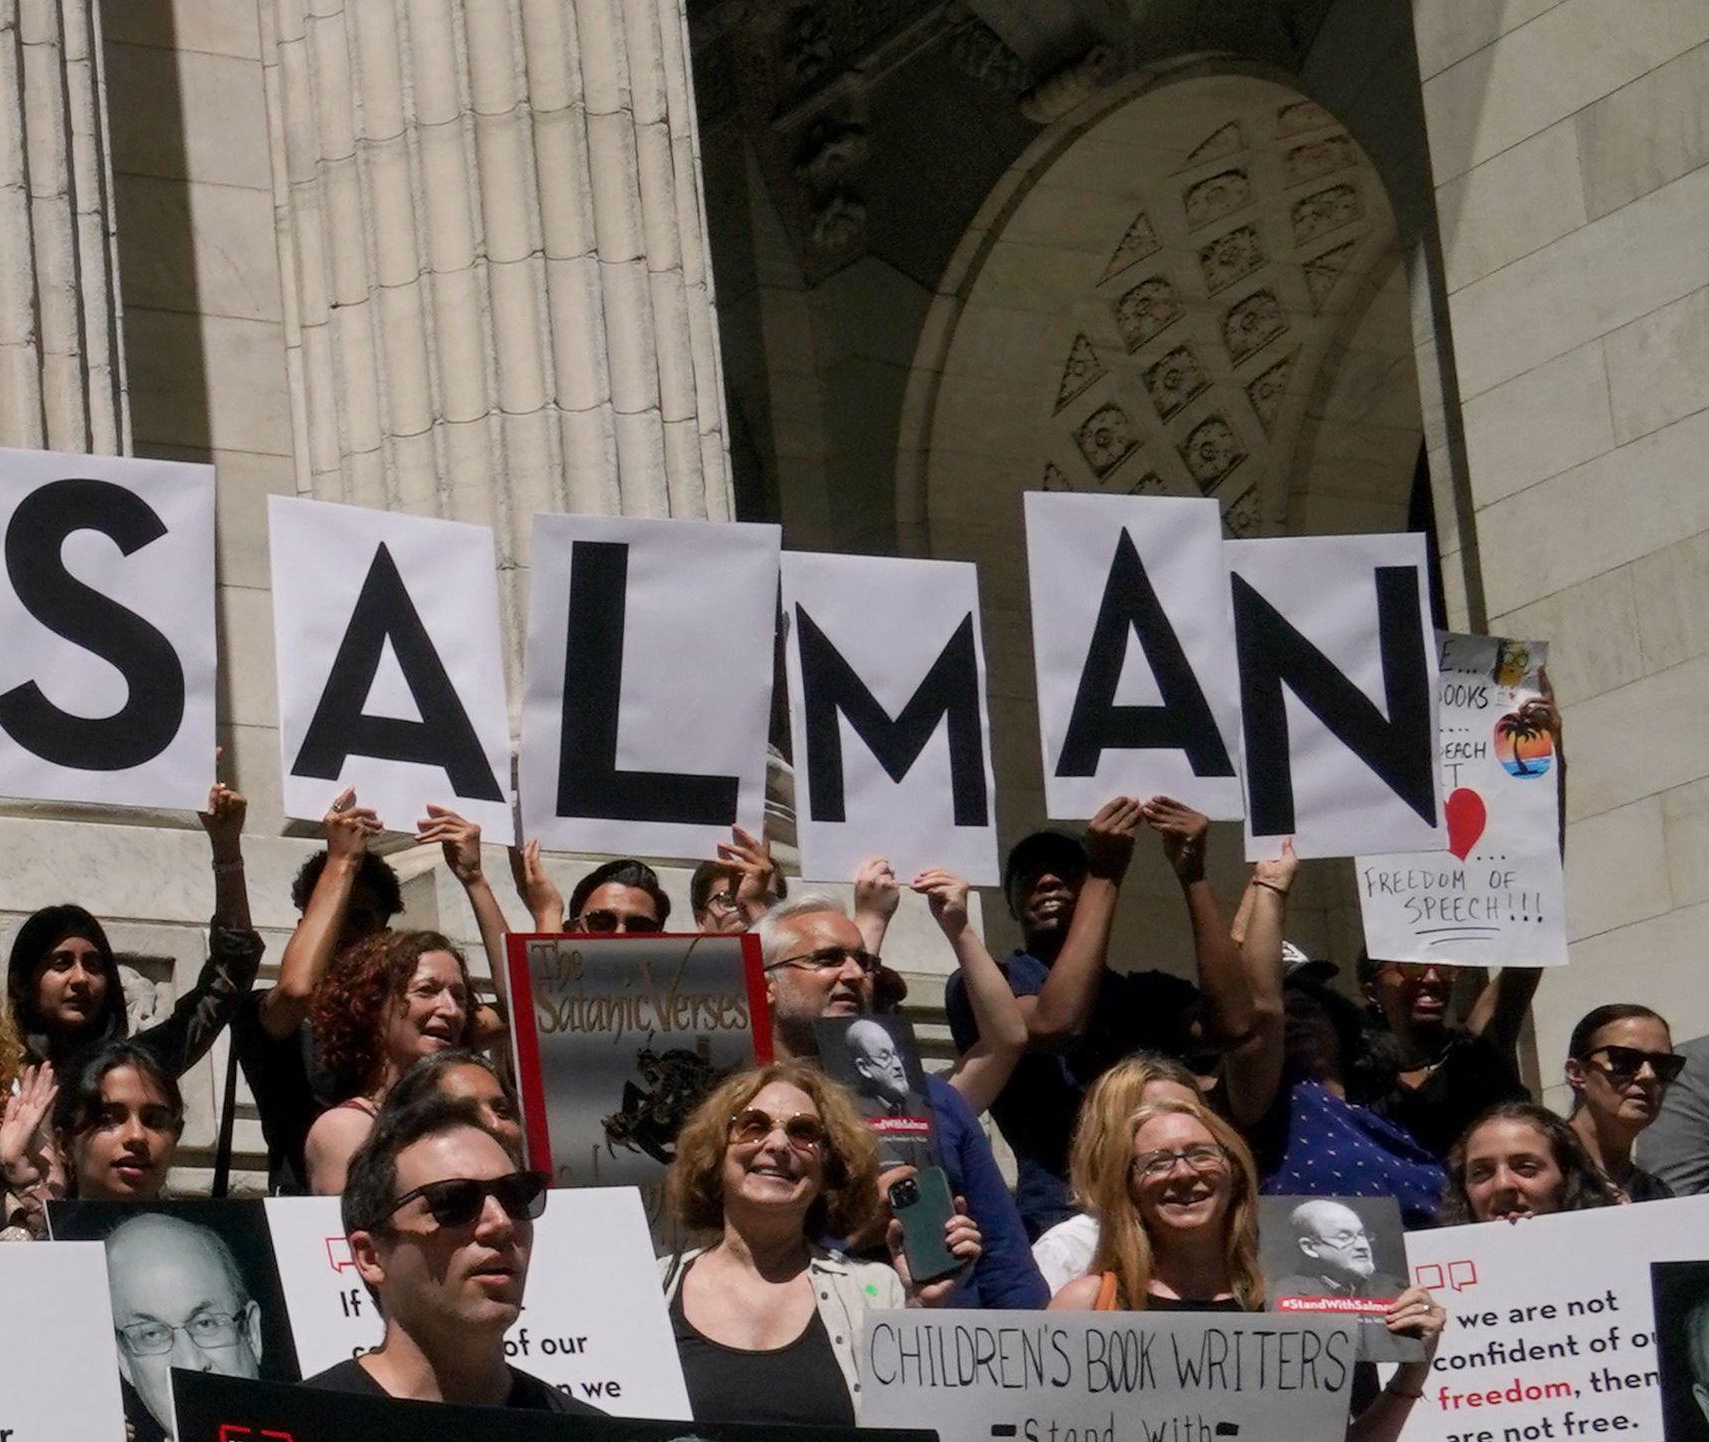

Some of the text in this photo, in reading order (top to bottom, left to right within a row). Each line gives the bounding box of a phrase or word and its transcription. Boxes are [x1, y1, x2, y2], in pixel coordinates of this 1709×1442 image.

[1365, 866, 1516, 898] FREEDOM OF
[531, 942, 583, 991] The
[538, 985, 749, 1043] Satanic Verses
[340, 1289, 361, 1317] If
[1456, 1290, 1619, 1329] we are not
[540, 1335, 587, 1355] our
[870, 1322, 1350, 1393] CHILDREN'S BOOK WRITERS
[1433, 1335, 1580, 1372] confident
[1589, 1327, 1620, 1354] of
[583, 1380, 621, 1398] we
[1438, 1378, 1582, 1411] freedom,
[1563, 1412, 1639, 1437] free.
